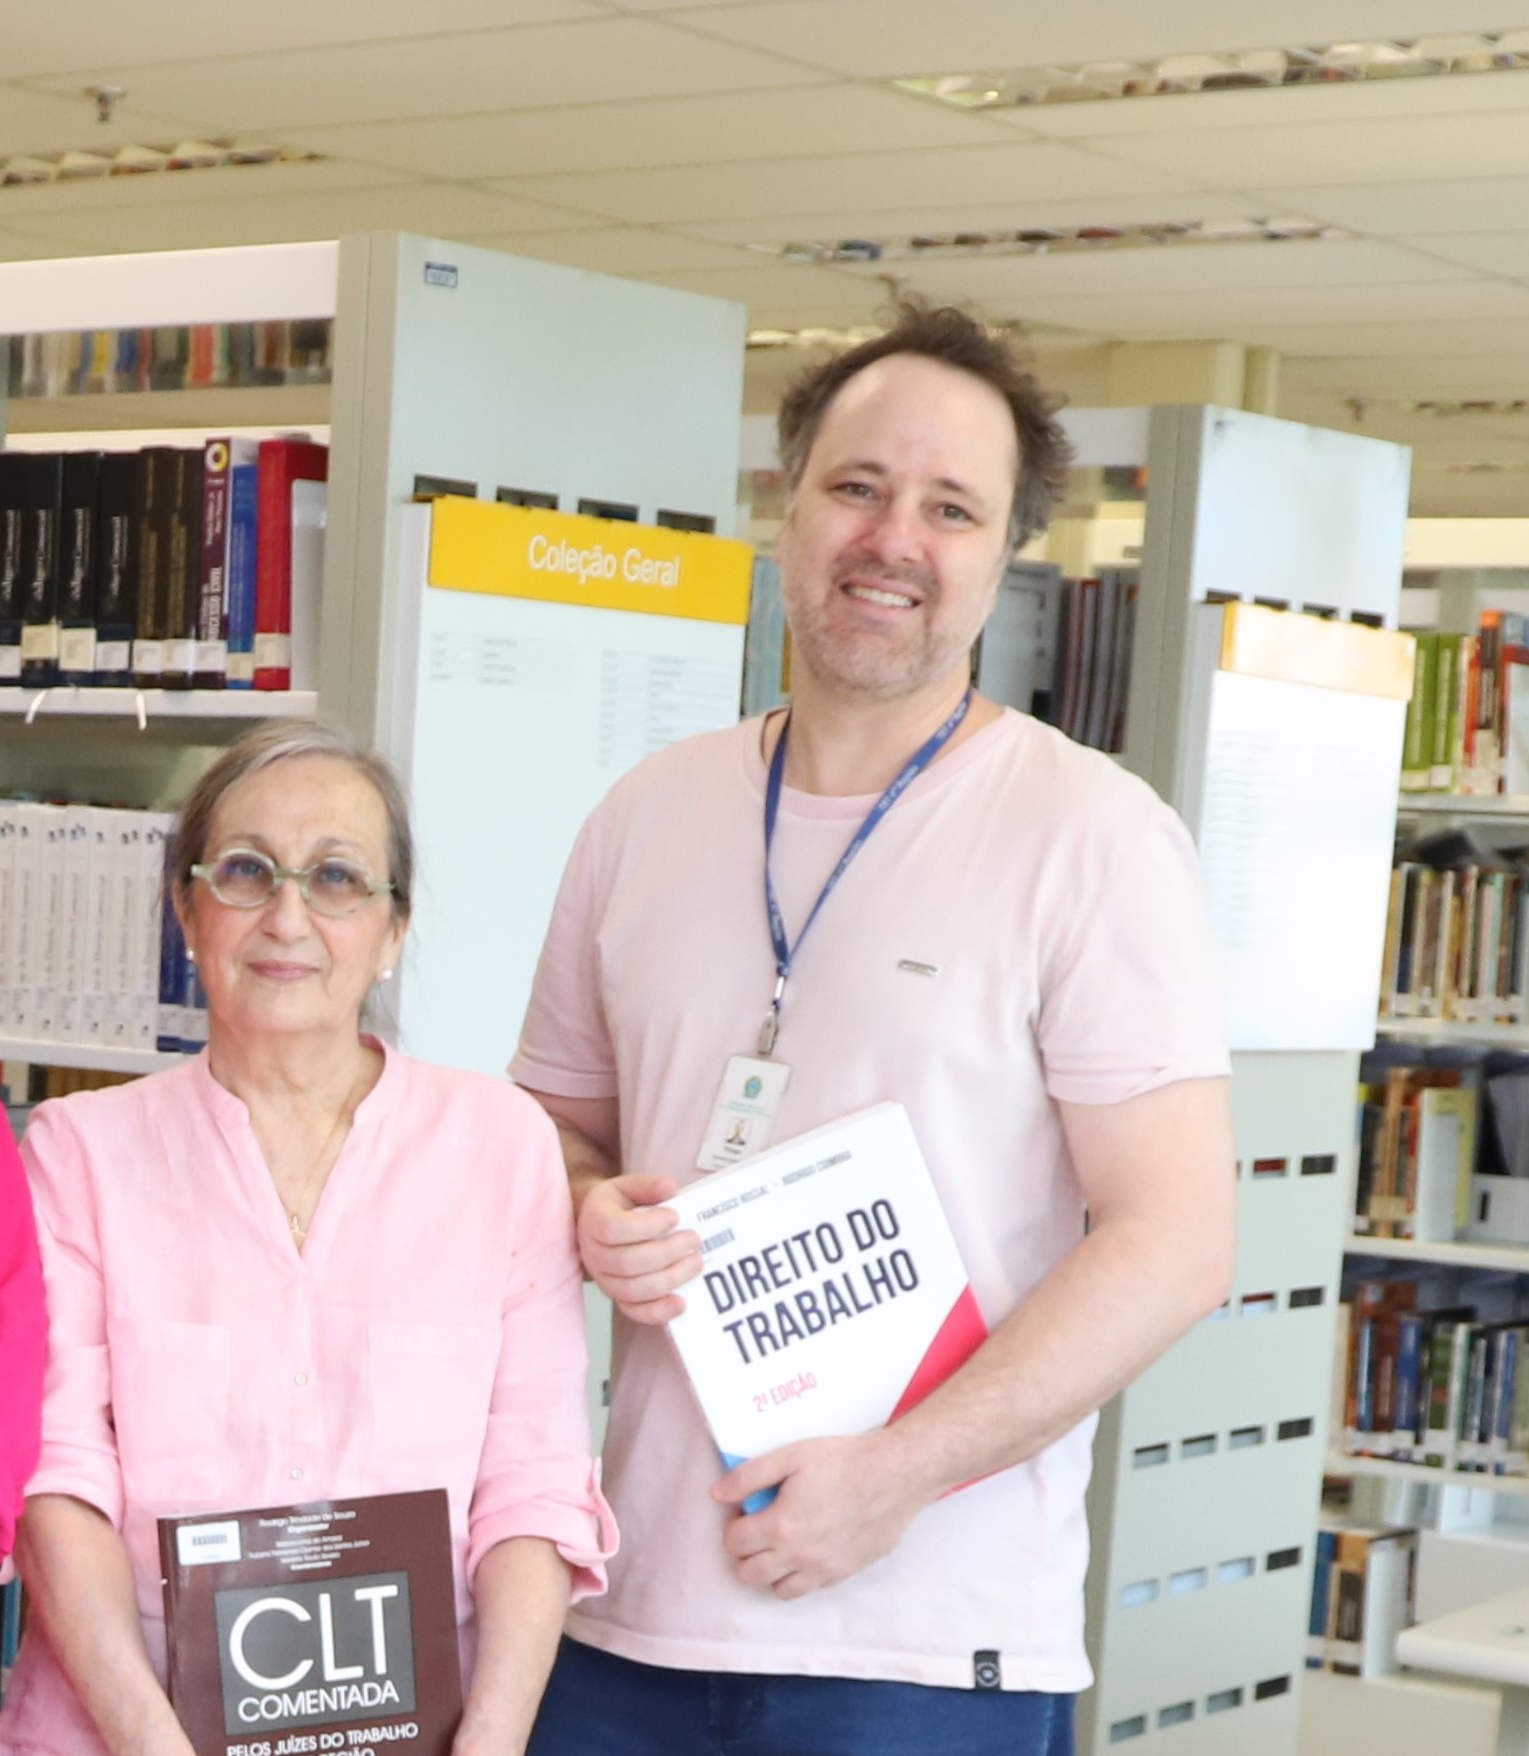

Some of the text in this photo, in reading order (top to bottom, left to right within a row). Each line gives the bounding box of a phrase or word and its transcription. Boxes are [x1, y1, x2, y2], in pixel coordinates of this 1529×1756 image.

[528, 534, 680, 587] Coleção Geral
[704, 1198, 901, 1315] DIREITO DO
[722, 1247, 920, 1365] TRABALHO
[772, 1371, 817, 1408] EDIÇÃO
[229, 1584, 398, 1690] CLT
[238, 1680, 399, 1723] COMENTADA
[274, 1734, 317, 1756] JUÍZES
[320, 1732, 344, 1751] DO
[347, 1723, 418, 1746] TRABALHO
